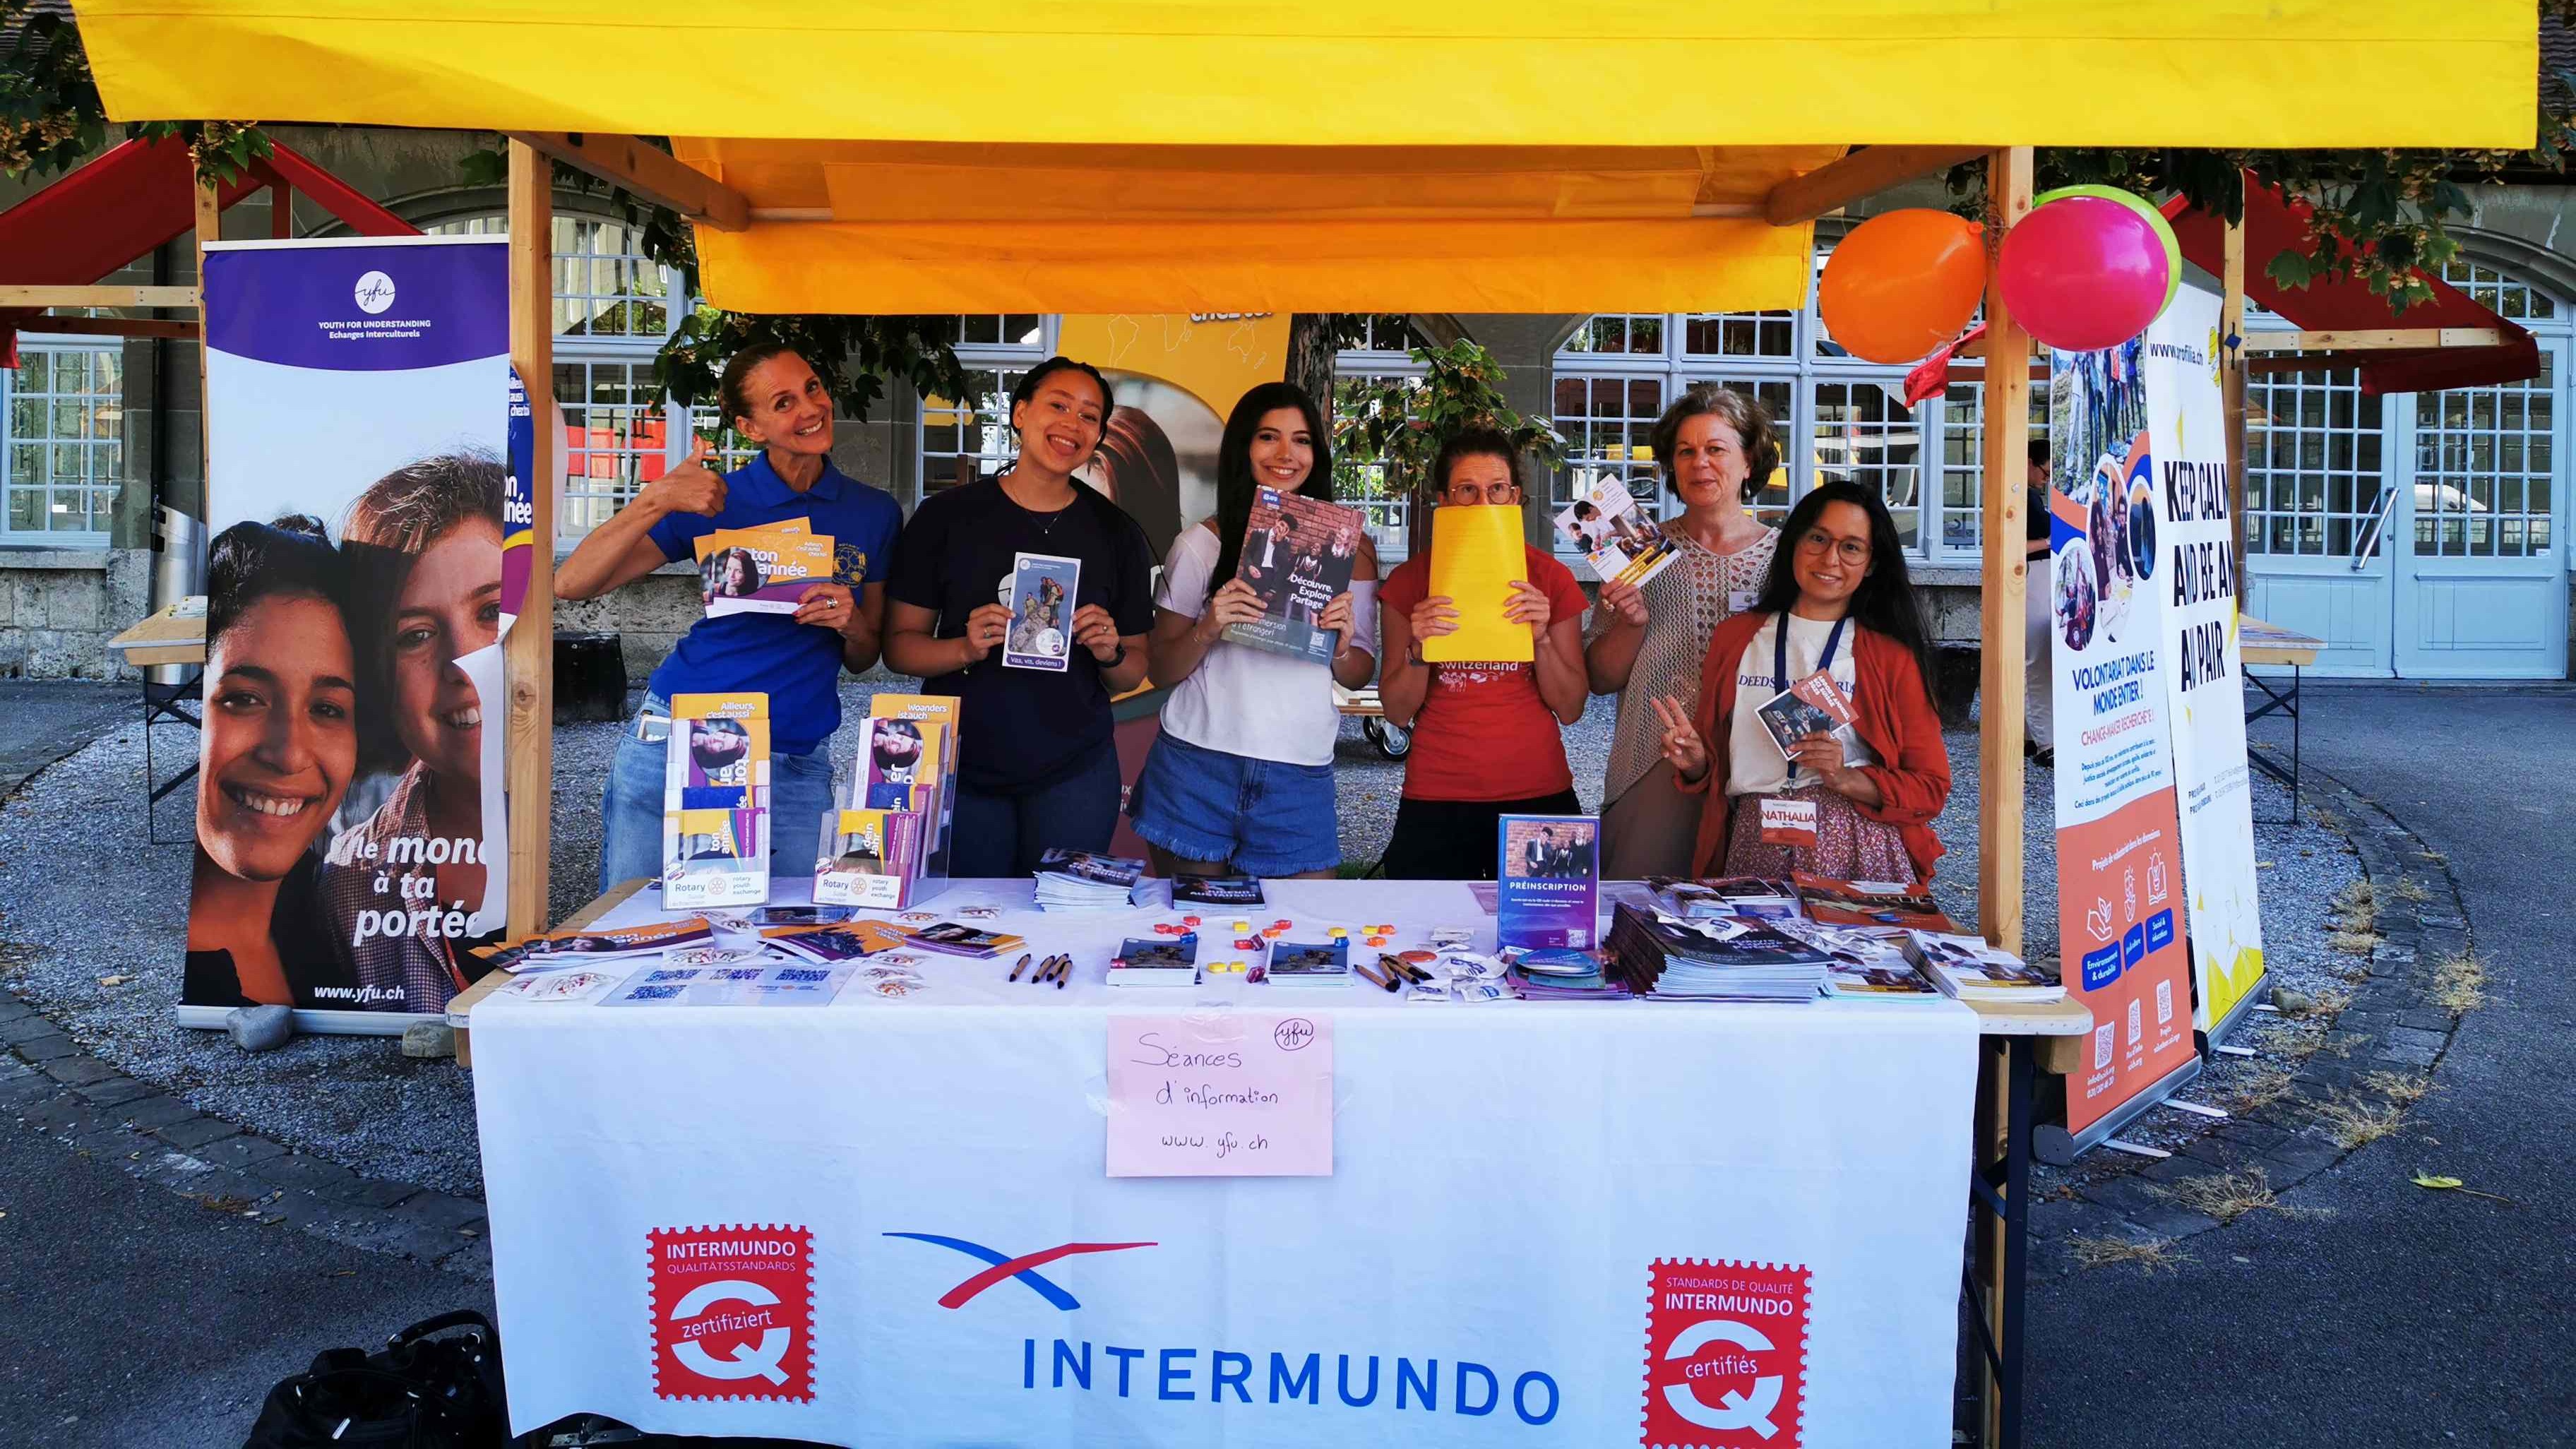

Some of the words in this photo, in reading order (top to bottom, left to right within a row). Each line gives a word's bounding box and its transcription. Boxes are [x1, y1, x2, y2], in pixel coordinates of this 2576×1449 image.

[329, 330, 364, 340] Echanges
[2164, 460, 2196, 523] KEEP
[503, 492, 532, 524] née
[751, 547, 778, 562] ton
[758, 561, 808, 577] année
[2174, 543, 2198, 607] AND
[2200, 542, 2216, 602] BE
[1289, 573, 1333, 593] Découvre.
[2181, 626, 2196, 693] AU
[2197, 619, 2226, 686] PAIR
[2072, 661, 2125, 691] VOLONTARIAT
[2126, 652, 2146, 676] DANS
[2147, 650, 2155, 672] LE
[907, 703, 947, 712] Woanders
[2093, 687, 2117, 716] MONDE
[2118, 680, 2140, 707] ENTIER
[1762, 810, 1815, 823] NATHALIA
[710, 832, 720, 852] ton
[719, 819, 730, 854] année
[862, 823, 873, 847] dein
[869, 833, 881, 857] Jahr
[357, 836, 379, 860] le
[387, 837, 487, 865] mon
[373, 870, 390, 893] à
[400, 872, 435, 899] ta
[675, 883, 706, 892] Rotary
[823, 878, 849, 890] Rotary
[1509, 880, 1587, 892] PRÉINSCRIPTION
[314, 984, 405, 1003] www.yfu.ch
[1156, 1080, 1278, 1109] d'information
[667, 1240, 797, 1260] INTERMUNDO
[667, 1261, 797, 1275] QUALITÄTSSTANDARDS
[1666, 1277, 1729, 1289] STANDARDS
[1731, 1280, 1746, 1291] DE
[1749, 1282, 1794, 1294] QUALITÉ
[1666, 1293, 1793, 1316] INTERMUNDO
[681, 1309, 773, 1339] zertifiziert
[1686, 1355, 1758, 1378] certifiés
[1023, 1338, 1560, 1426] INTERMUNDO
